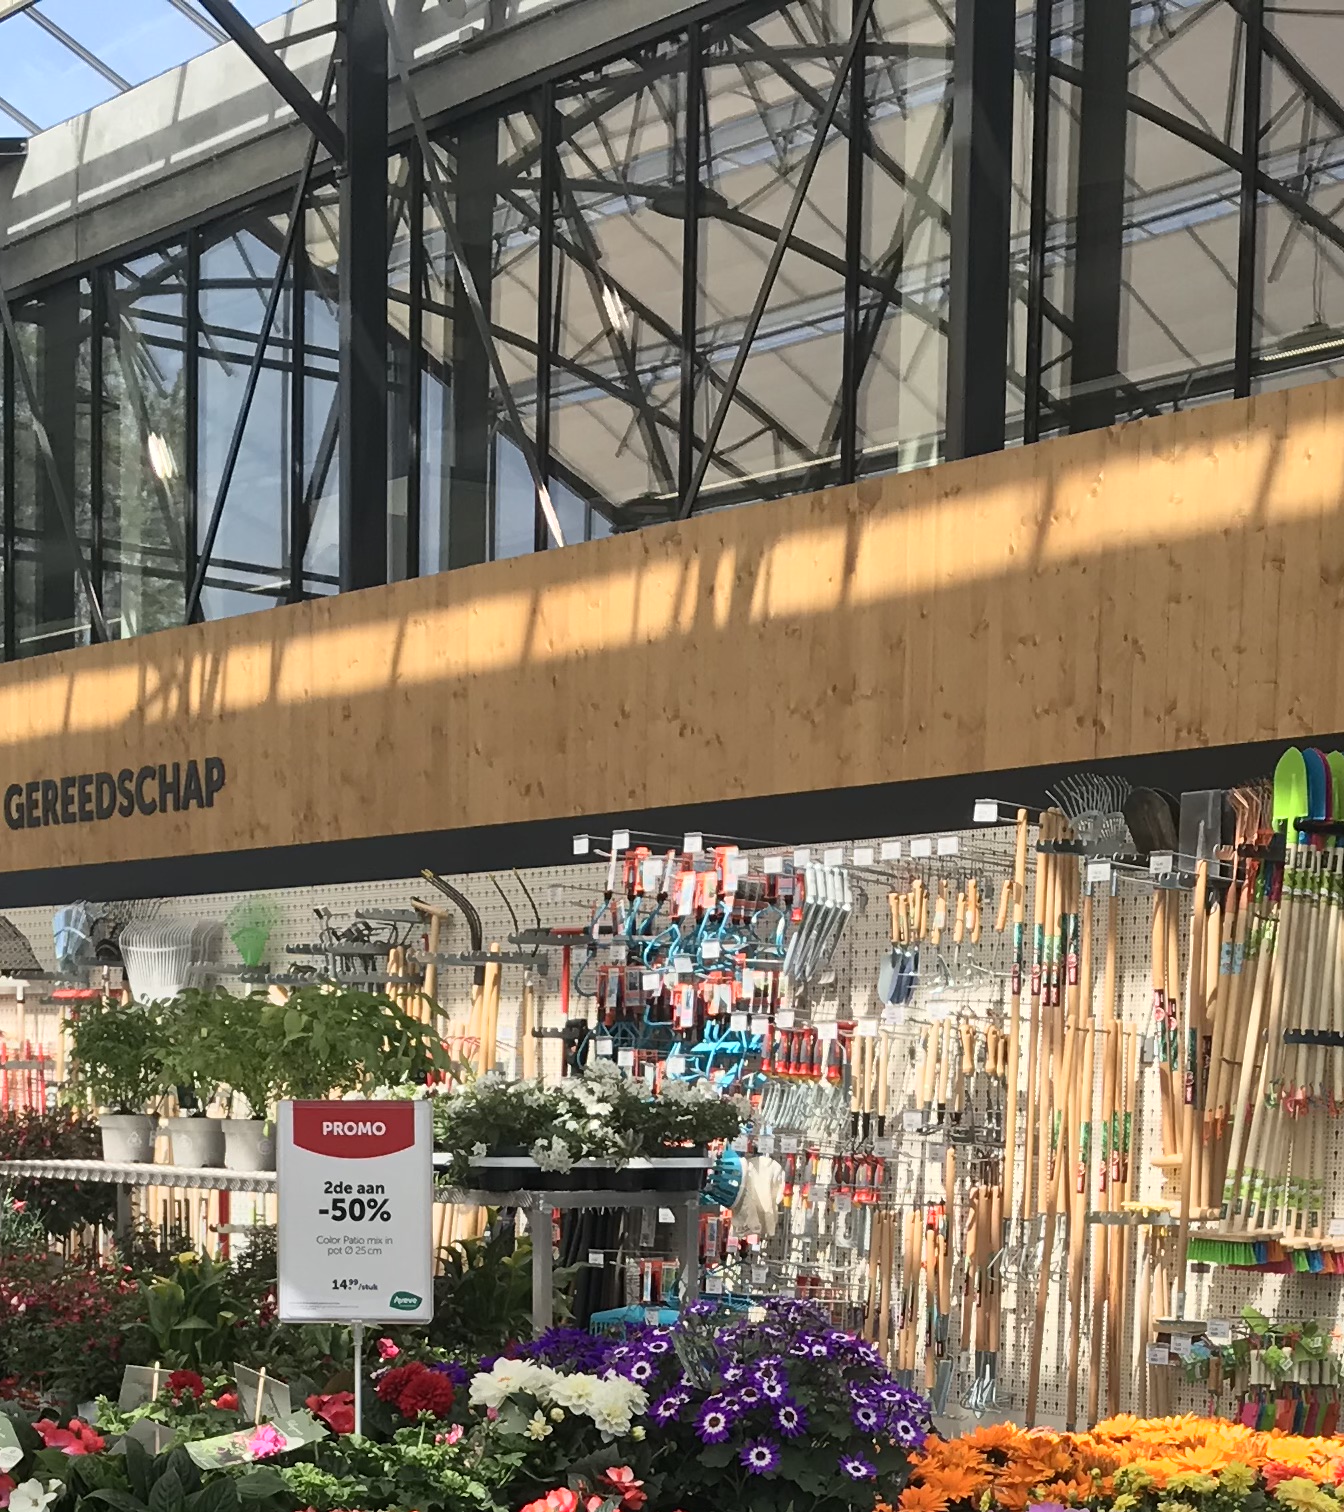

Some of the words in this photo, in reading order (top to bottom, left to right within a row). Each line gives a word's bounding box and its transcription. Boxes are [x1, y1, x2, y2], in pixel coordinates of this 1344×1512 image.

[4, 757, 226, 830] GEREEDSCHAP
[322, 1121, 386, 1136] PROMO
[324, 1181, 353, 1195] 2de
[357, 1183, 385, 1195] aan
[319, 1197, 392, 1222] -50%
[316, 1235, 341, 1245] Color
[343, 1235, 365, 1245] Patio
[367, 1236, 383, 1245] mix
[385, 1236, 393, 1245] in
[327, 1246, 343, 1257] pot
